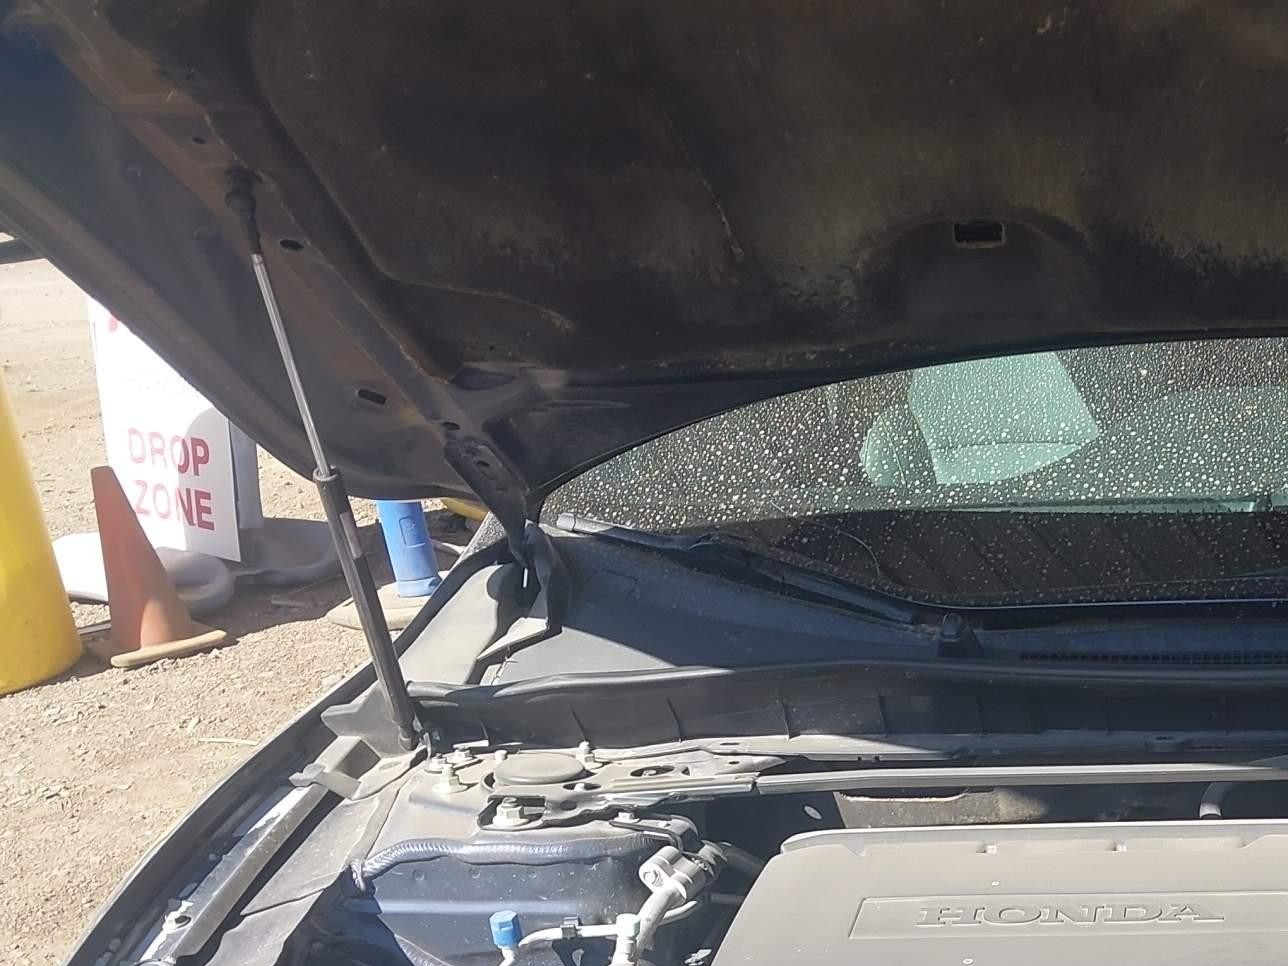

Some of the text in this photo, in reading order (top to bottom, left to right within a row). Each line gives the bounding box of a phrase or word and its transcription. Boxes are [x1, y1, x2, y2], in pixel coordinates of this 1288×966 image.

[128, 427, 210, 477] DROP
[132, 479, 215, 531] ZONE
[916, 903, 1225, 926] HONDA
